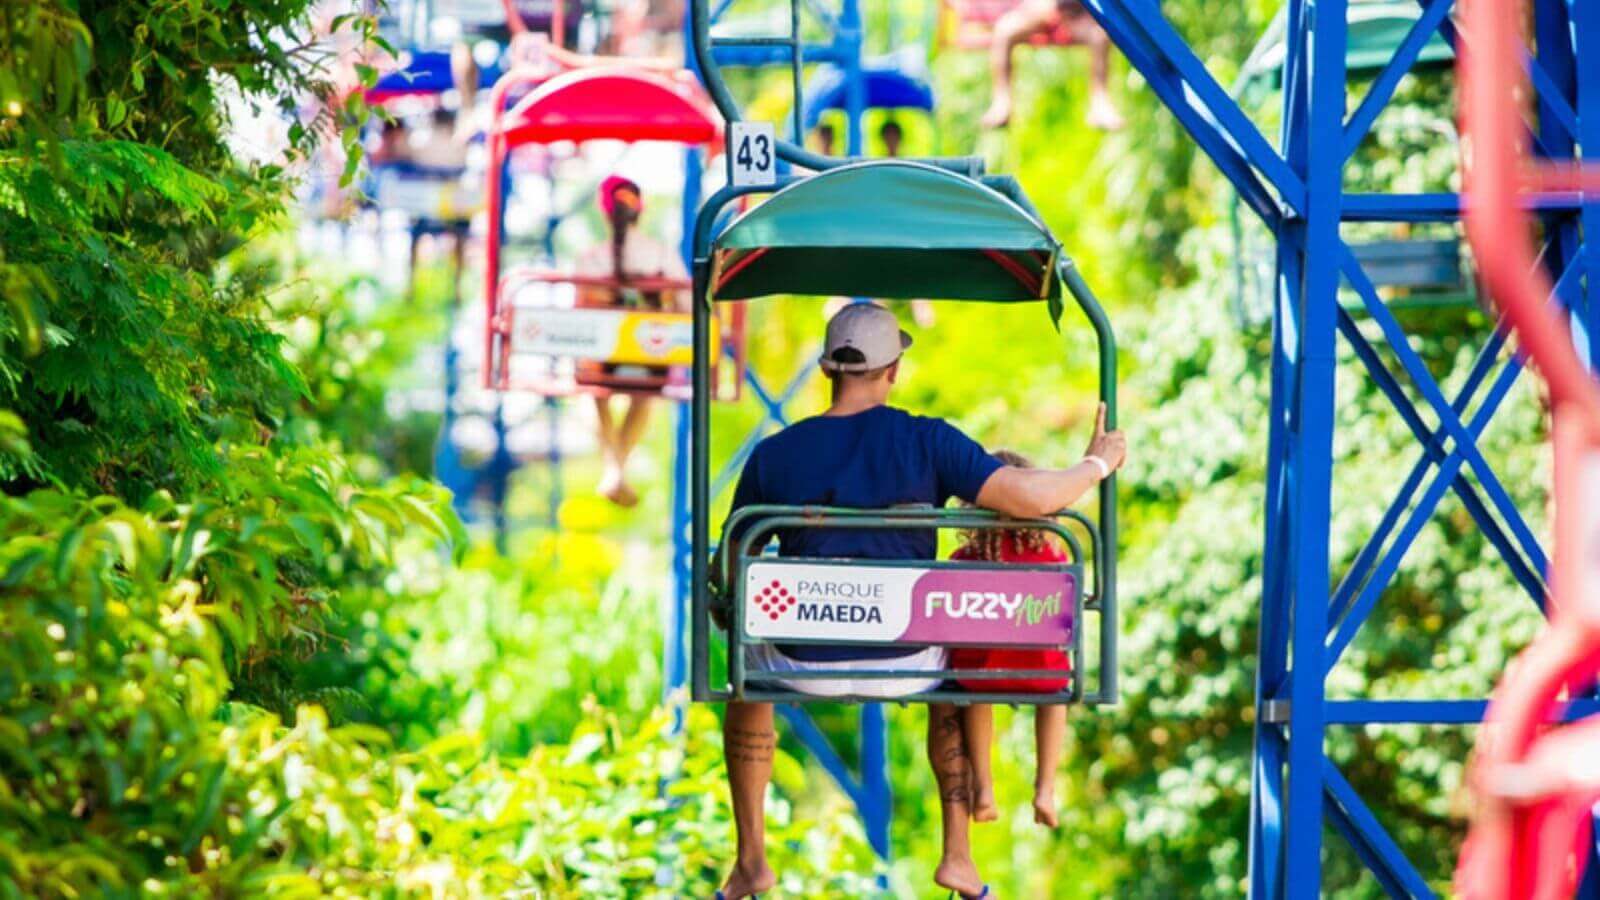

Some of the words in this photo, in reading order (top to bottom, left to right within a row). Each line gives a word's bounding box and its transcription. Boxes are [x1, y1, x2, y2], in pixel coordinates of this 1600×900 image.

[737, 134, 770, 171] 43
[797, 581, 884, 598] PARQUE
[797, 602, 882, 624] MAEDA
[925, 591, 1022, 619] FUZZY
